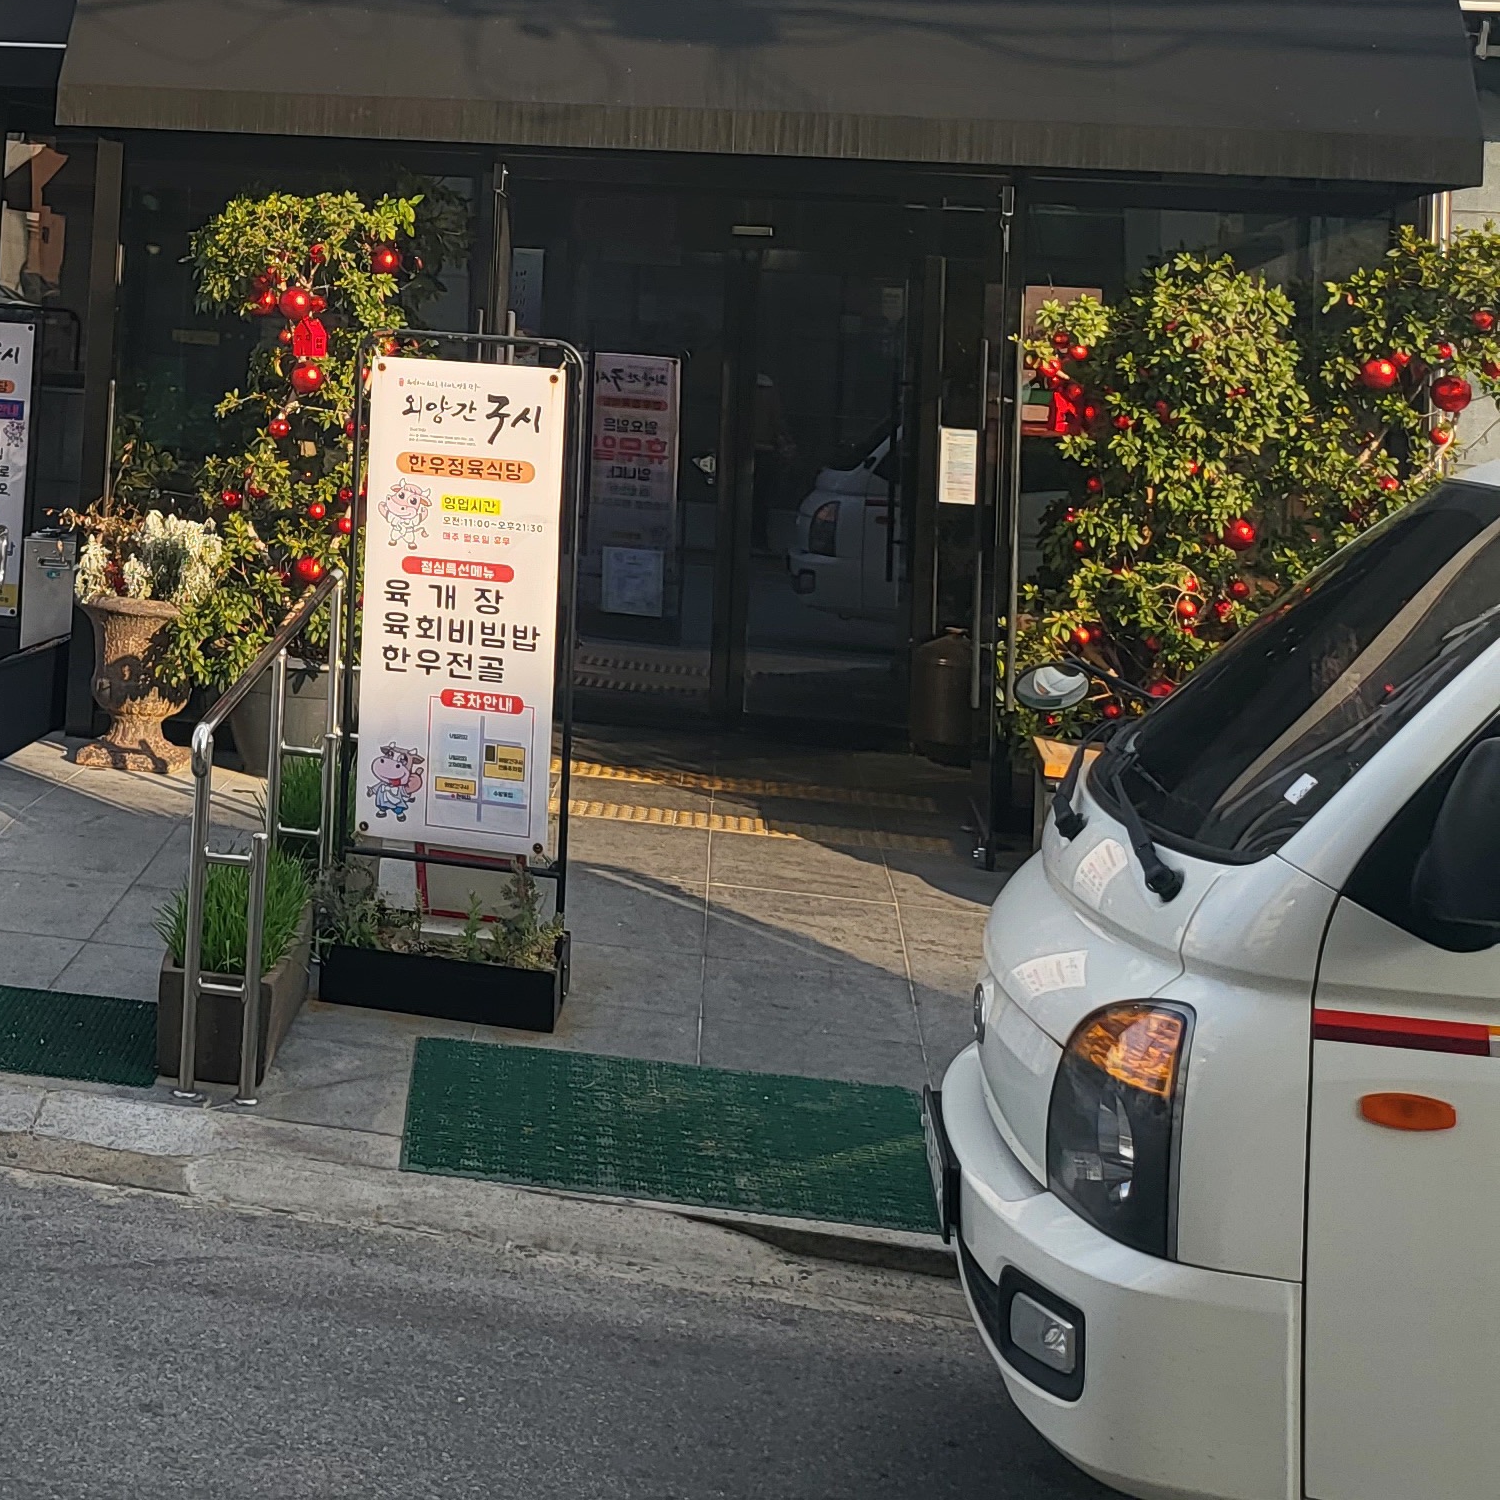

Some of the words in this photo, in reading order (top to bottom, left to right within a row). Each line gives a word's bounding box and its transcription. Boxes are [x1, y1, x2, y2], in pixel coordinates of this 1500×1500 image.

[402, 394, 477, 423] 외양간
[408, 454, 523, 481] 한우정육식당
[444, 496, 496, 514] 영업시간
[463, 533, 490, 544] 월요일
[420, 560, 495, 579] 점심특선메뉴
[382, 611, 541, 652] 육회비빔밥
[381, 644, 505, 684] 한우전골
[451, 691, 513, 713] 주차안내
